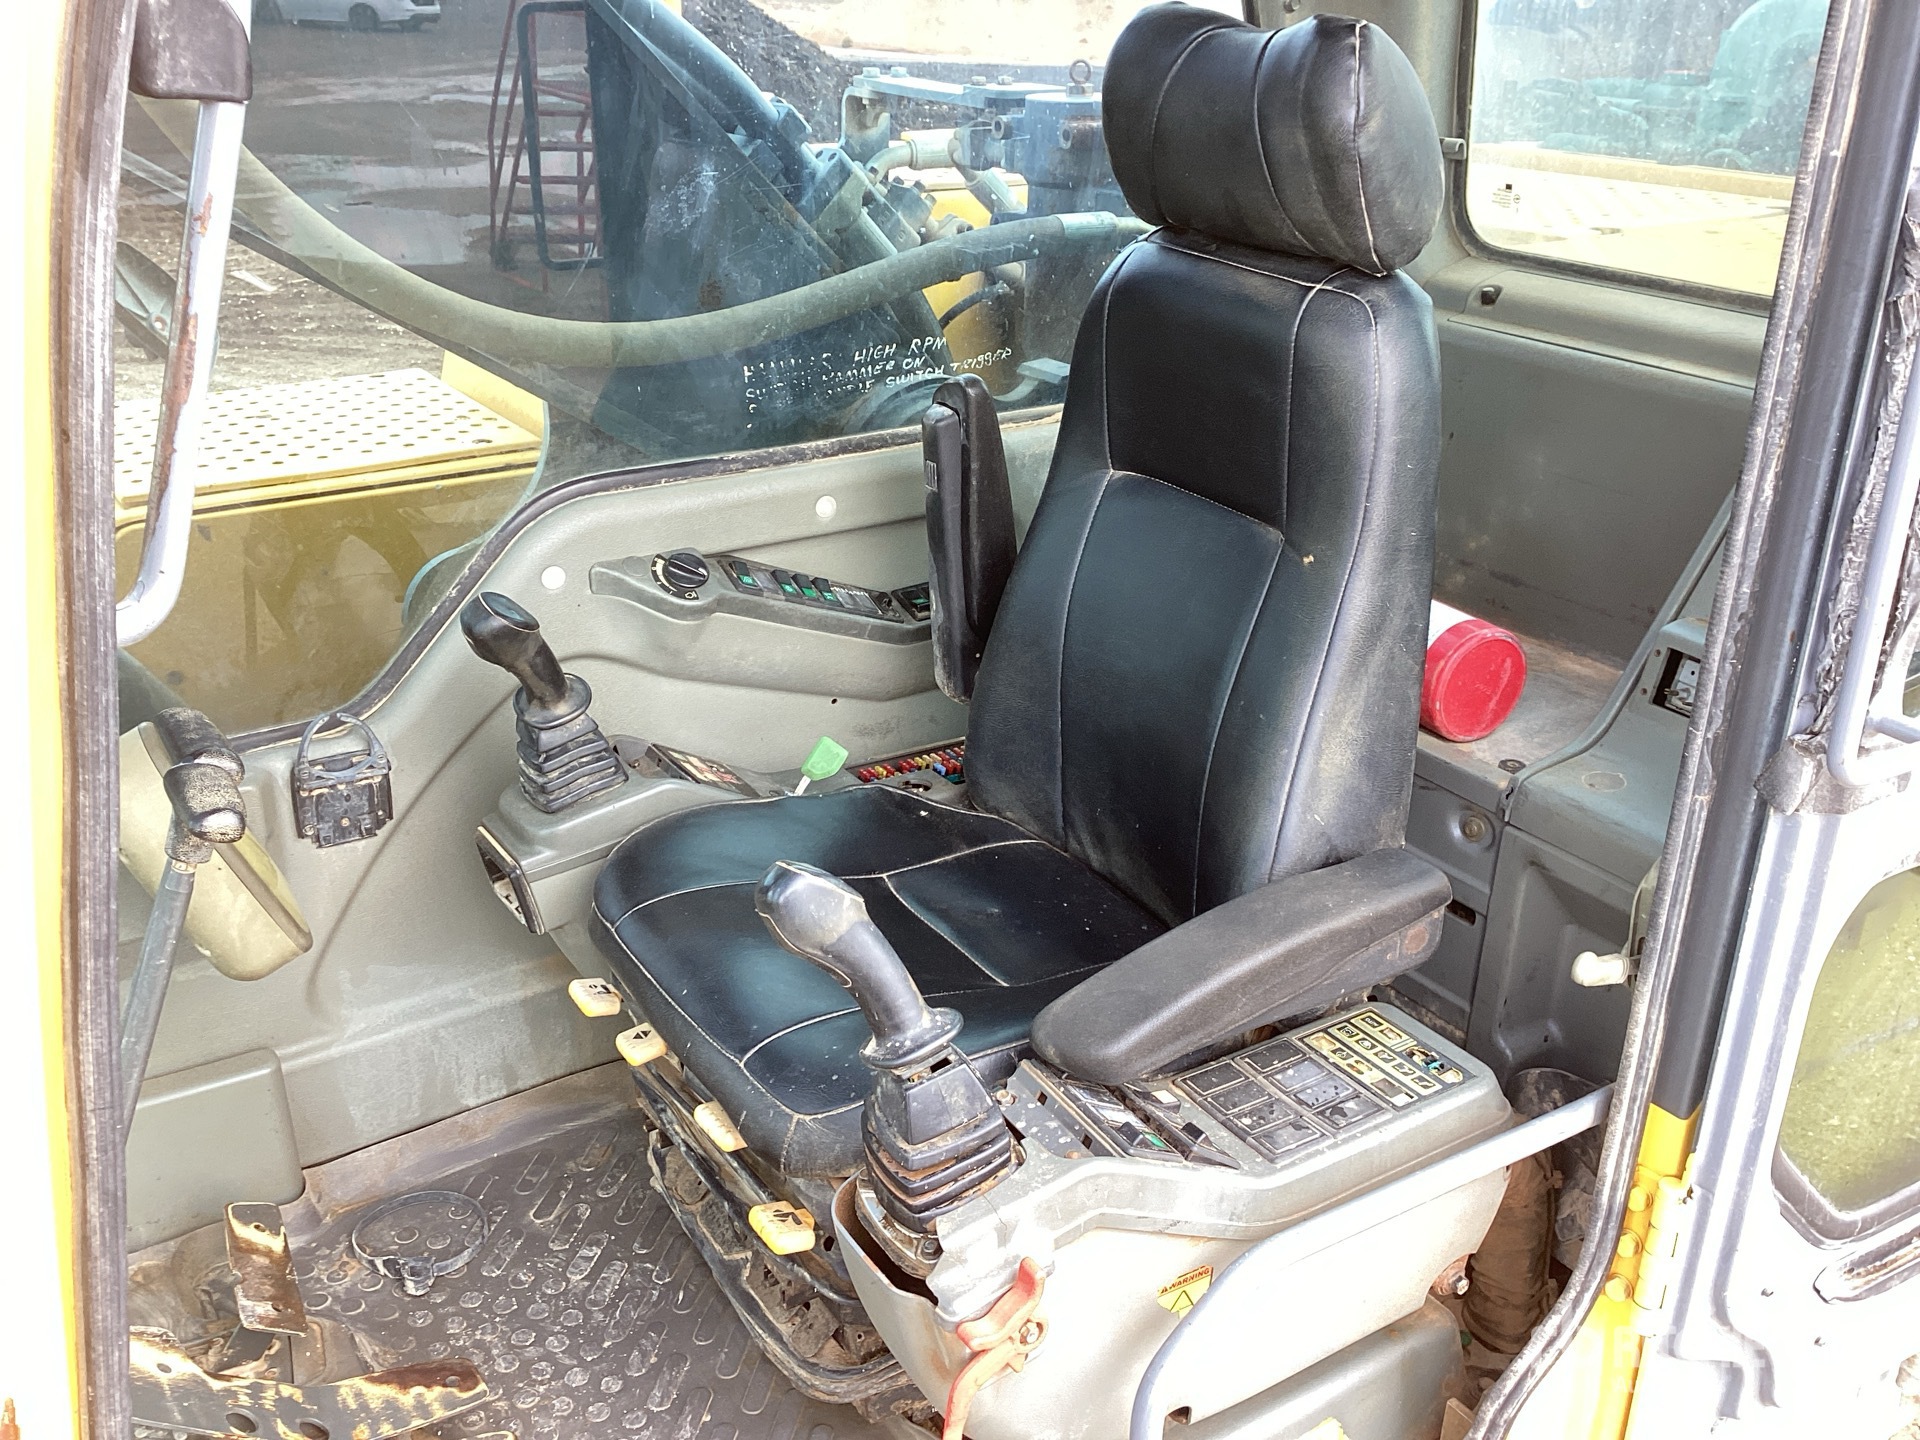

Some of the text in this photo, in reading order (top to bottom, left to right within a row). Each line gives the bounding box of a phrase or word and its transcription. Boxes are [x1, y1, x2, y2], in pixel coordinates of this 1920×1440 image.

[854, 336, 947, 366] HIGH RPM
[902, 356, 926, 370] ON
[885, 364, 944, 388] SWITCH
[1169, 1267, 1210, 1290] WARNING
